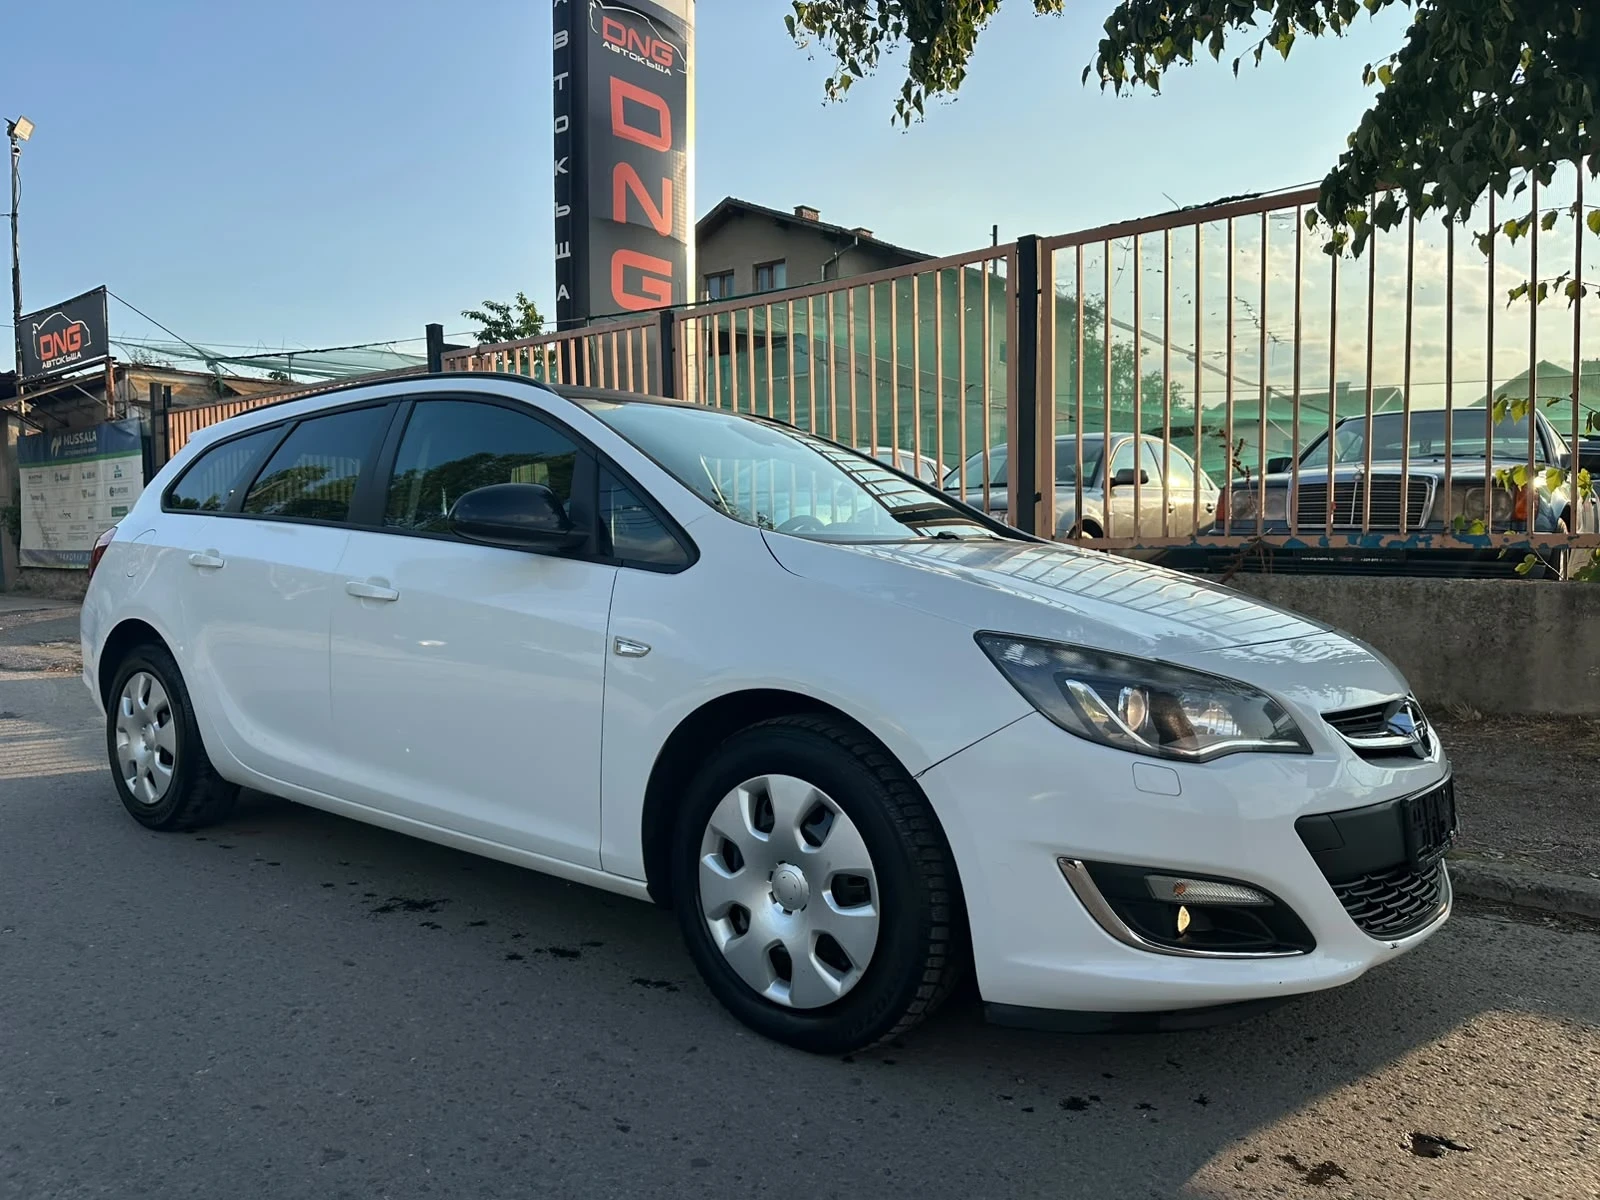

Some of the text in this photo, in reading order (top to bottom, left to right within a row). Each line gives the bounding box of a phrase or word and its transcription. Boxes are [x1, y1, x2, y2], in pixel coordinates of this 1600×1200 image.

[602, 16, 673, 67] DNG
[610, 75, 672, 311] DNG
[39, 324, 81, 360] DNG
[63, 430, 97, 446] MUSSALA
